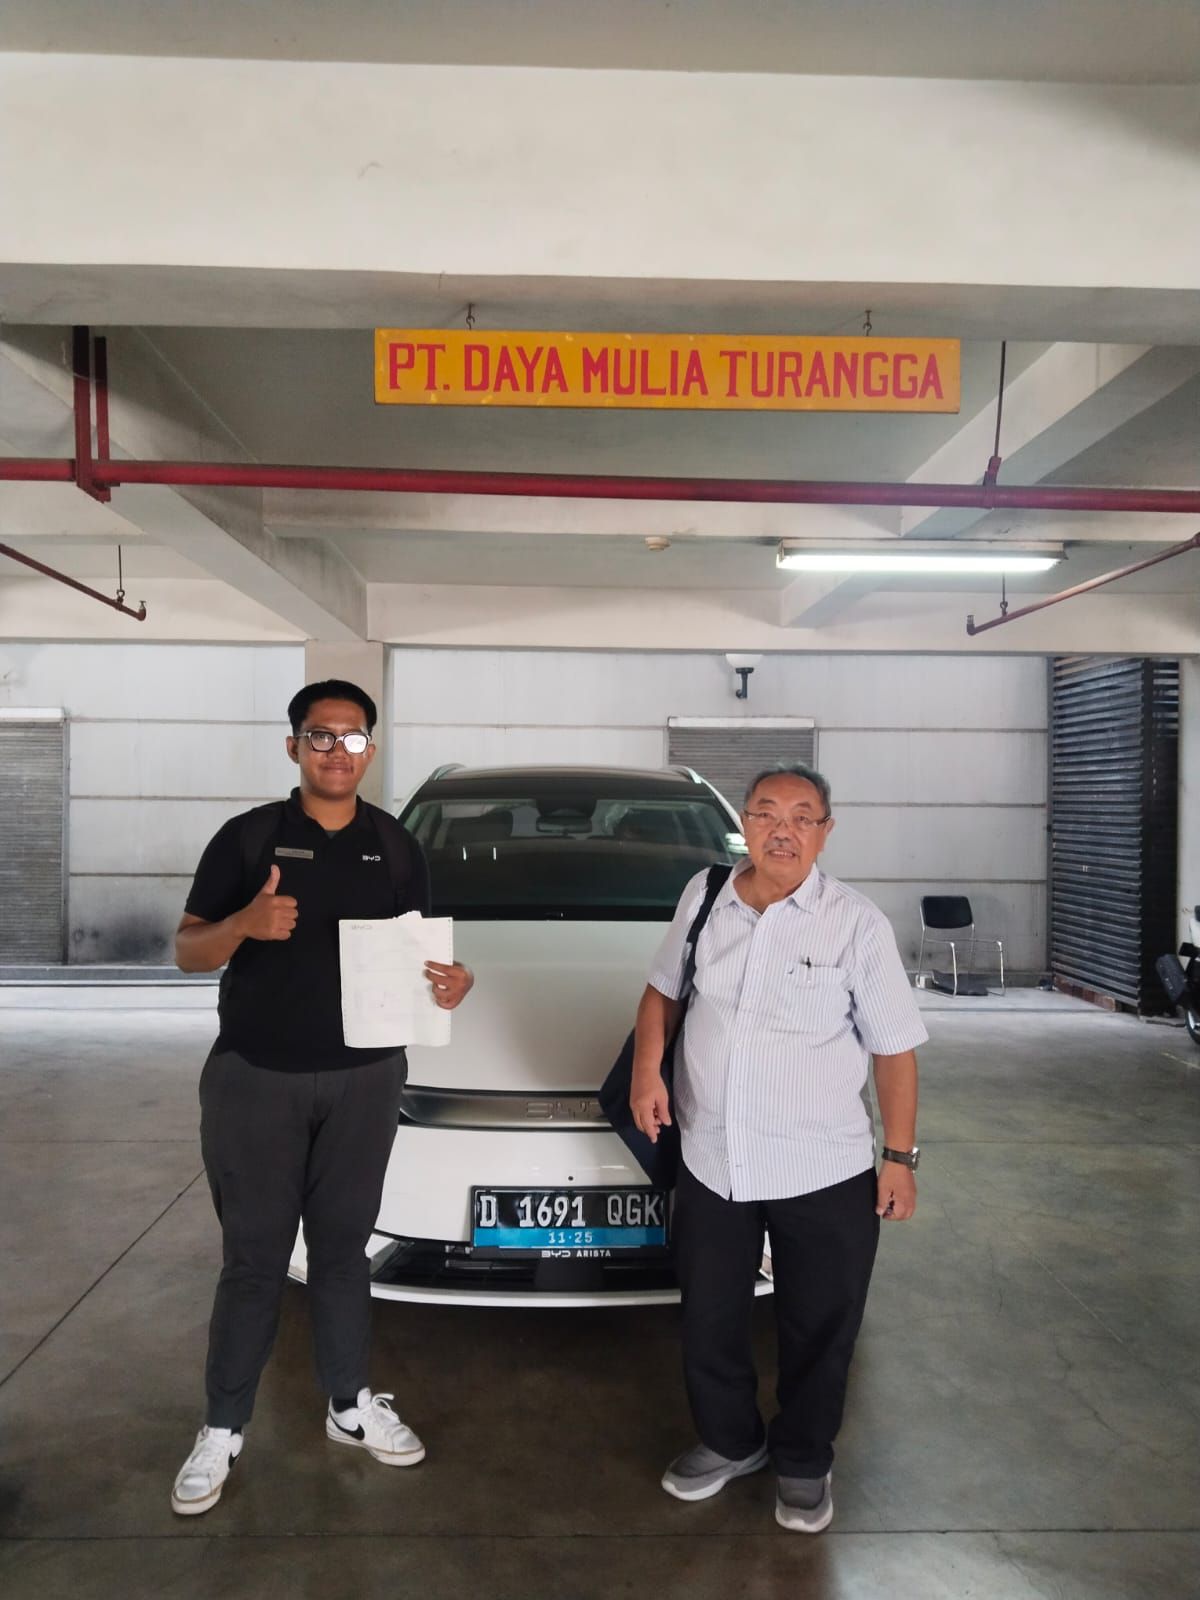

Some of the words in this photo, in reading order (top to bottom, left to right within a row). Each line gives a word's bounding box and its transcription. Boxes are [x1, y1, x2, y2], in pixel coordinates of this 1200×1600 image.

[389, 343, 450, 390] PT.
[464, 344, 569, 393] DAYA
[582, 346, 709, 396] MULIA
[719, 350, 944, 399] TURANGGA
[480, 1195, 497, 1227] D
[519, 1195, 586, 1227] 1691
[607, 1194, 661, 1226] QGK
[541, 1250, 571, 1258] BYD
[576, 1250, 611, 1258] ARISTA
